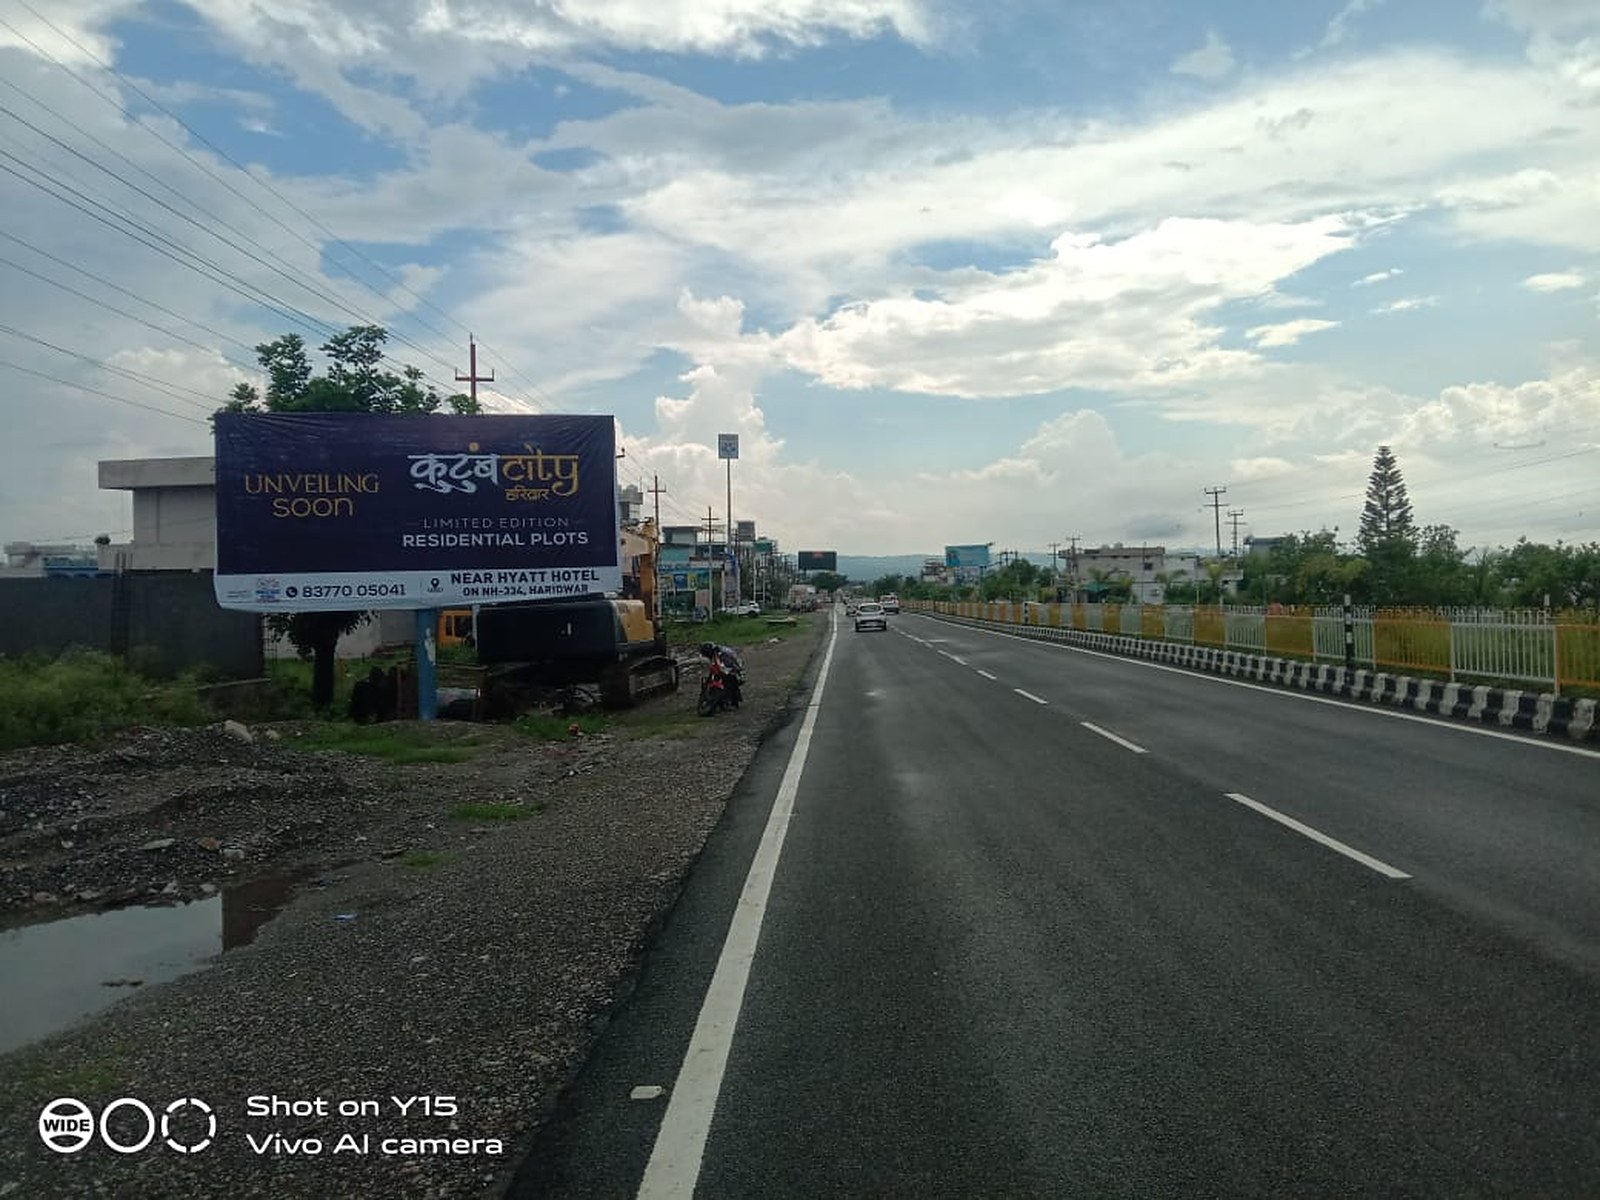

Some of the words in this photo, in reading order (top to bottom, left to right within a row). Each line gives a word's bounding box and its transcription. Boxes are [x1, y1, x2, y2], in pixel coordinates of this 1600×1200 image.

[245, 474, 379, 493] UNVEILING
[423, 518, 493, 529] LIMITED
[500, 518, 569, 528] EDITION
[402, 534, 525, 547] RESIDENTIAL
[531, 532, 589, 545] PLOTS
[451, 572, 493, 585] NEAR
[497, 571, 548, 583] HYATT
[551, 570, 600, 582] HOTEL
[302, 586, 352, 598] 83770
[357, 584, 406, 597] 05041
[463, 587, 479, 597] ON
[529, 584, 588, 594] HARIDWAR
